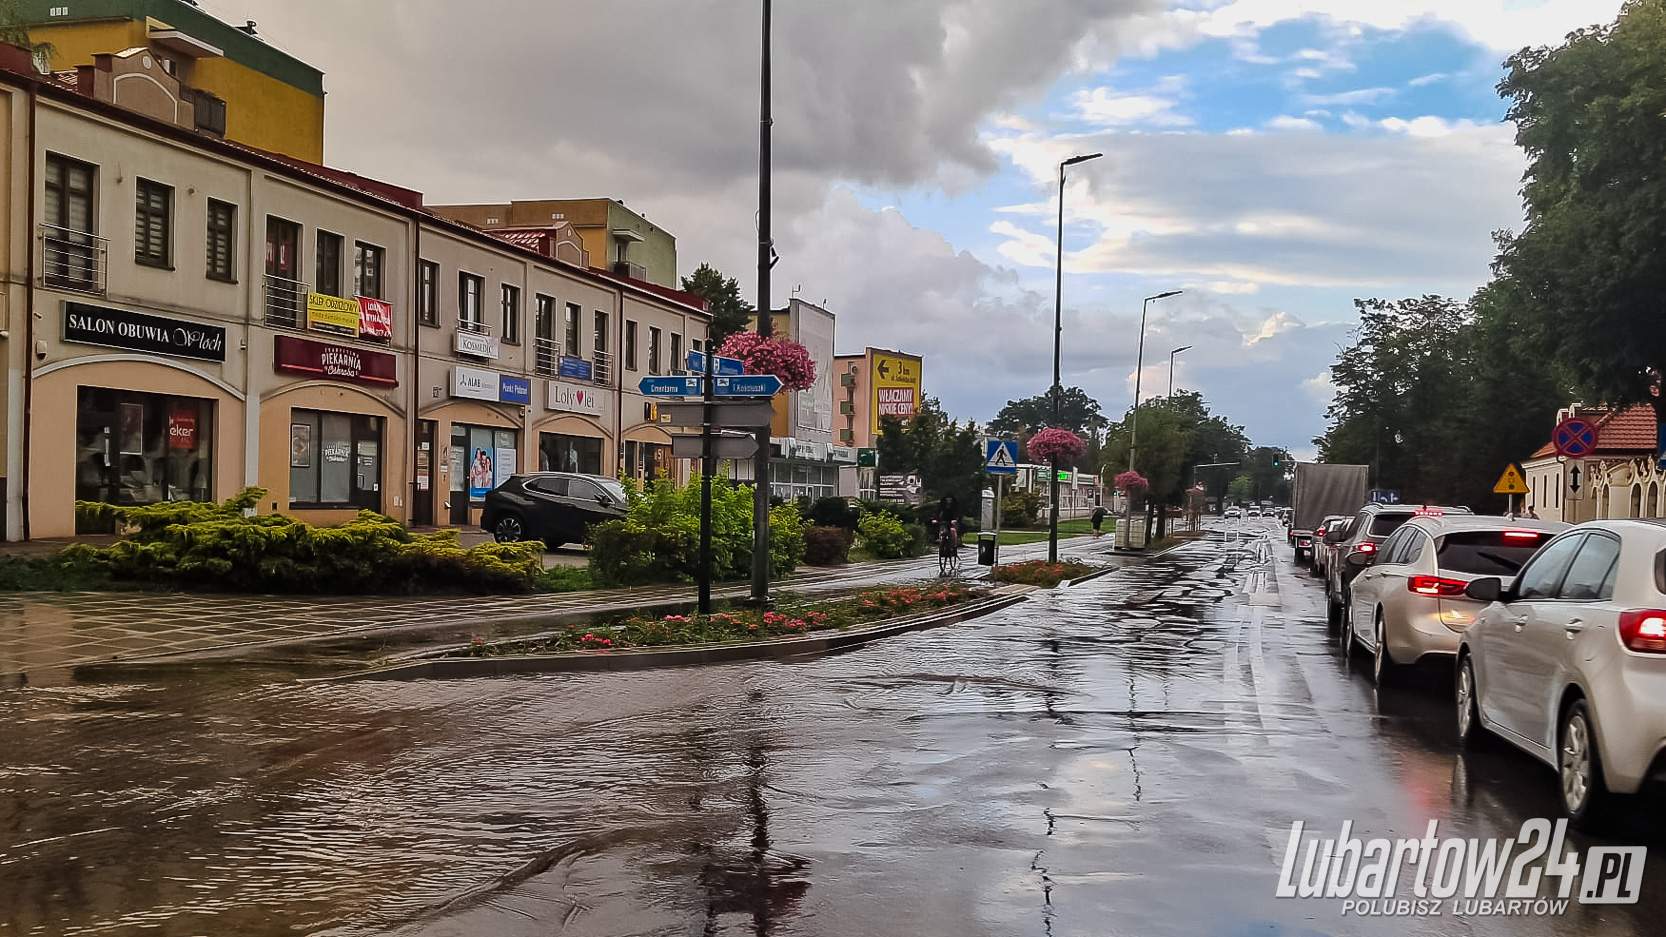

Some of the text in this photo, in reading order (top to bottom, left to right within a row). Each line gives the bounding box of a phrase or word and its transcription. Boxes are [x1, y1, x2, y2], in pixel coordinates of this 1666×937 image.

[68, 313, 115, 334] SALON
[118, 321, 169, 343] OBUWIA
[321, 352, 361, 371] PIEKARNIA
[898, 361, 903, 375] 3
[878, 388, 914, 403] WŁĄCZAMY
